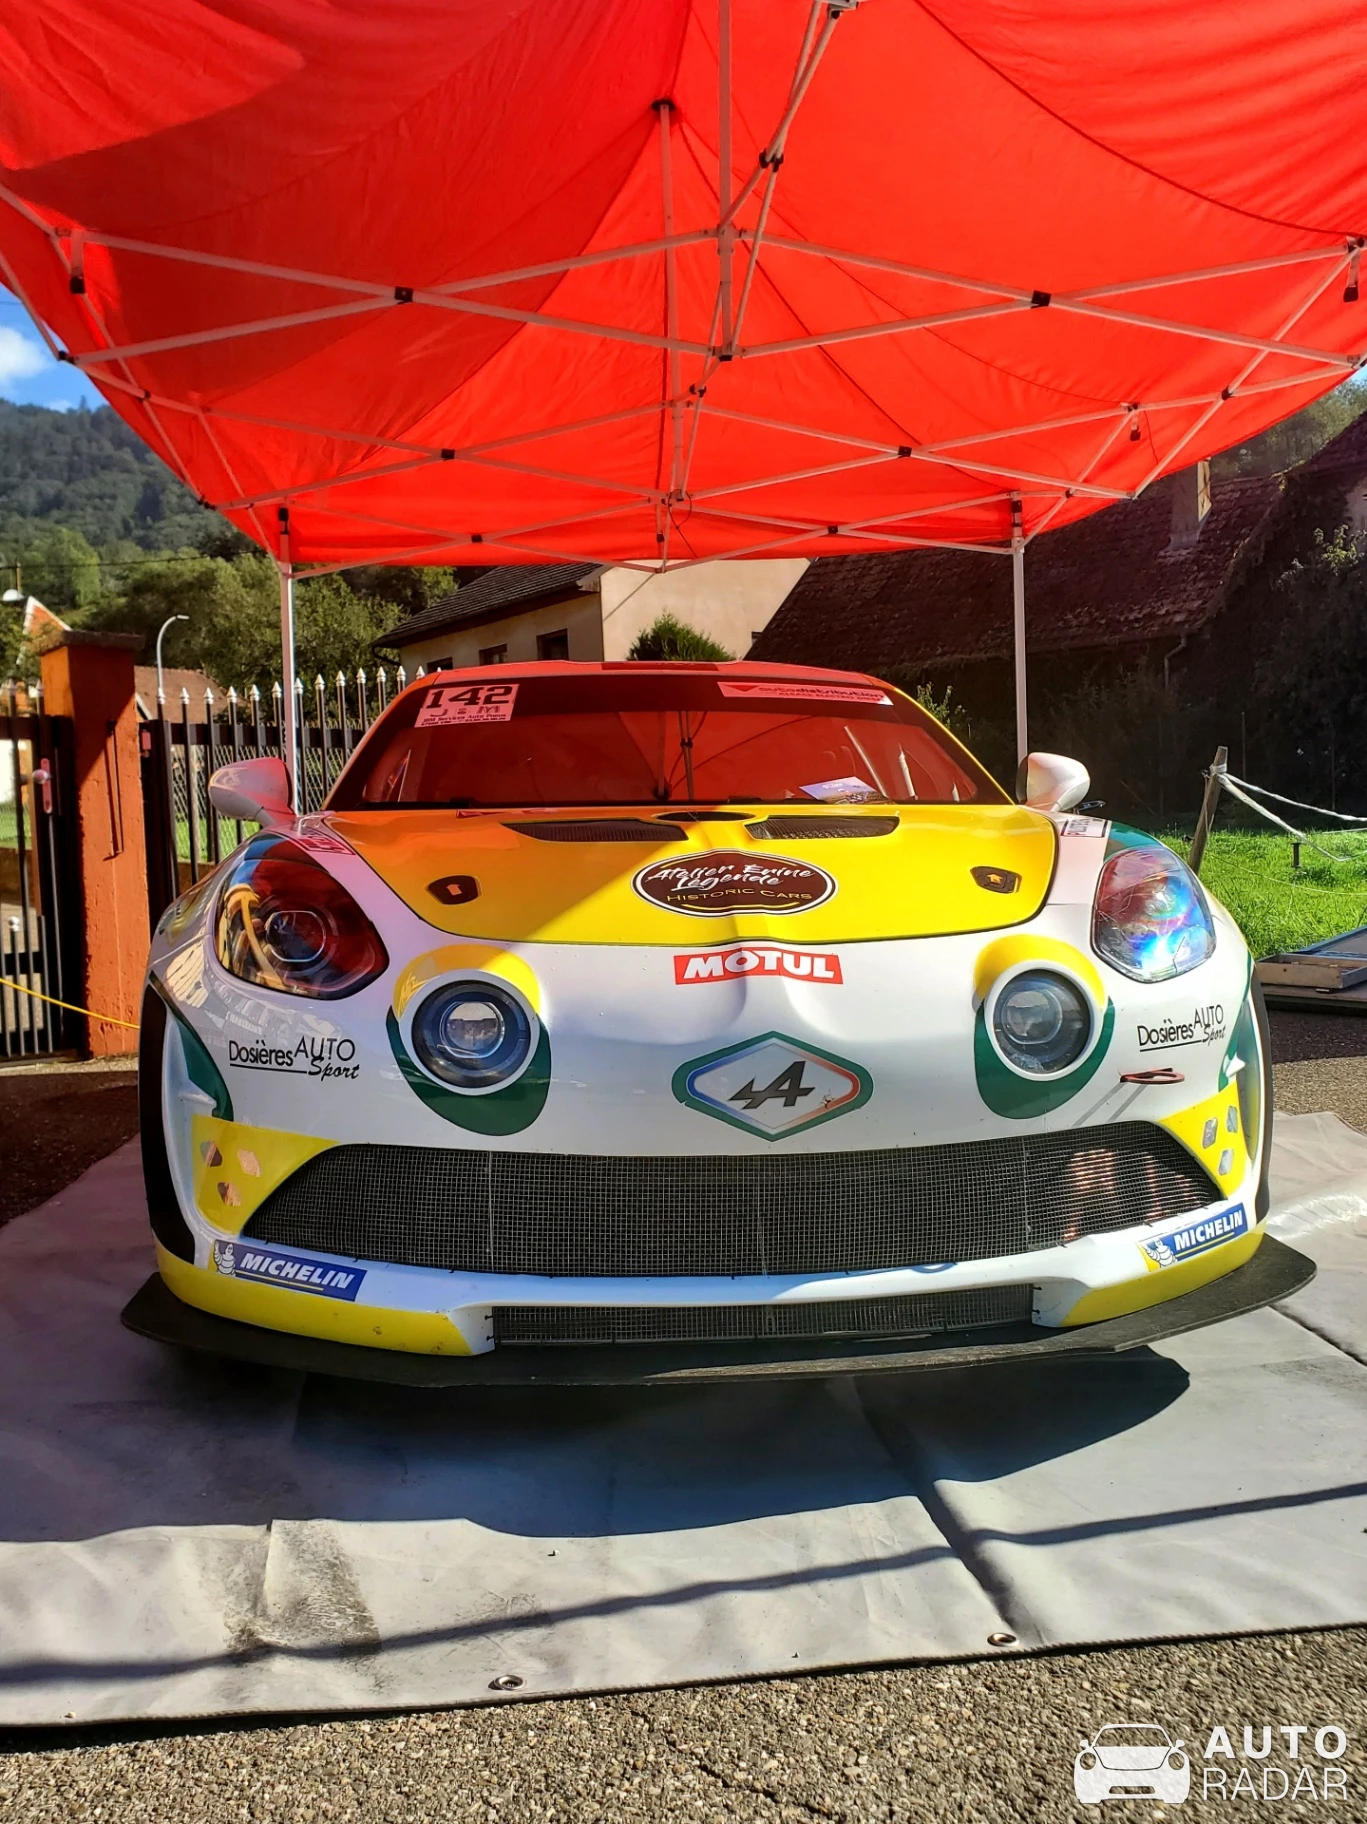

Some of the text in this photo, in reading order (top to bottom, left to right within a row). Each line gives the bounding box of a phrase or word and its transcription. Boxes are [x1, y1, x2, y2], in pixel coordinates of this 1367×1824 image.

[426, 685, 513, 709] 142
[645, 864, 735, 883] Atelier
[683, 950, 835, 980] MOTUL
[1137, 1004, 1224, 1047] Dosières AUTO
[1202, 1023, 1227, 1047] Sport
[229, 1035, 356, 1067] Dosières AUTO
[307, 1056, 360, 1082] Sport
[1173, 1209, 1243, 1252] MICHELIN
[239, 1252, 356, 1290] MICHELIN
